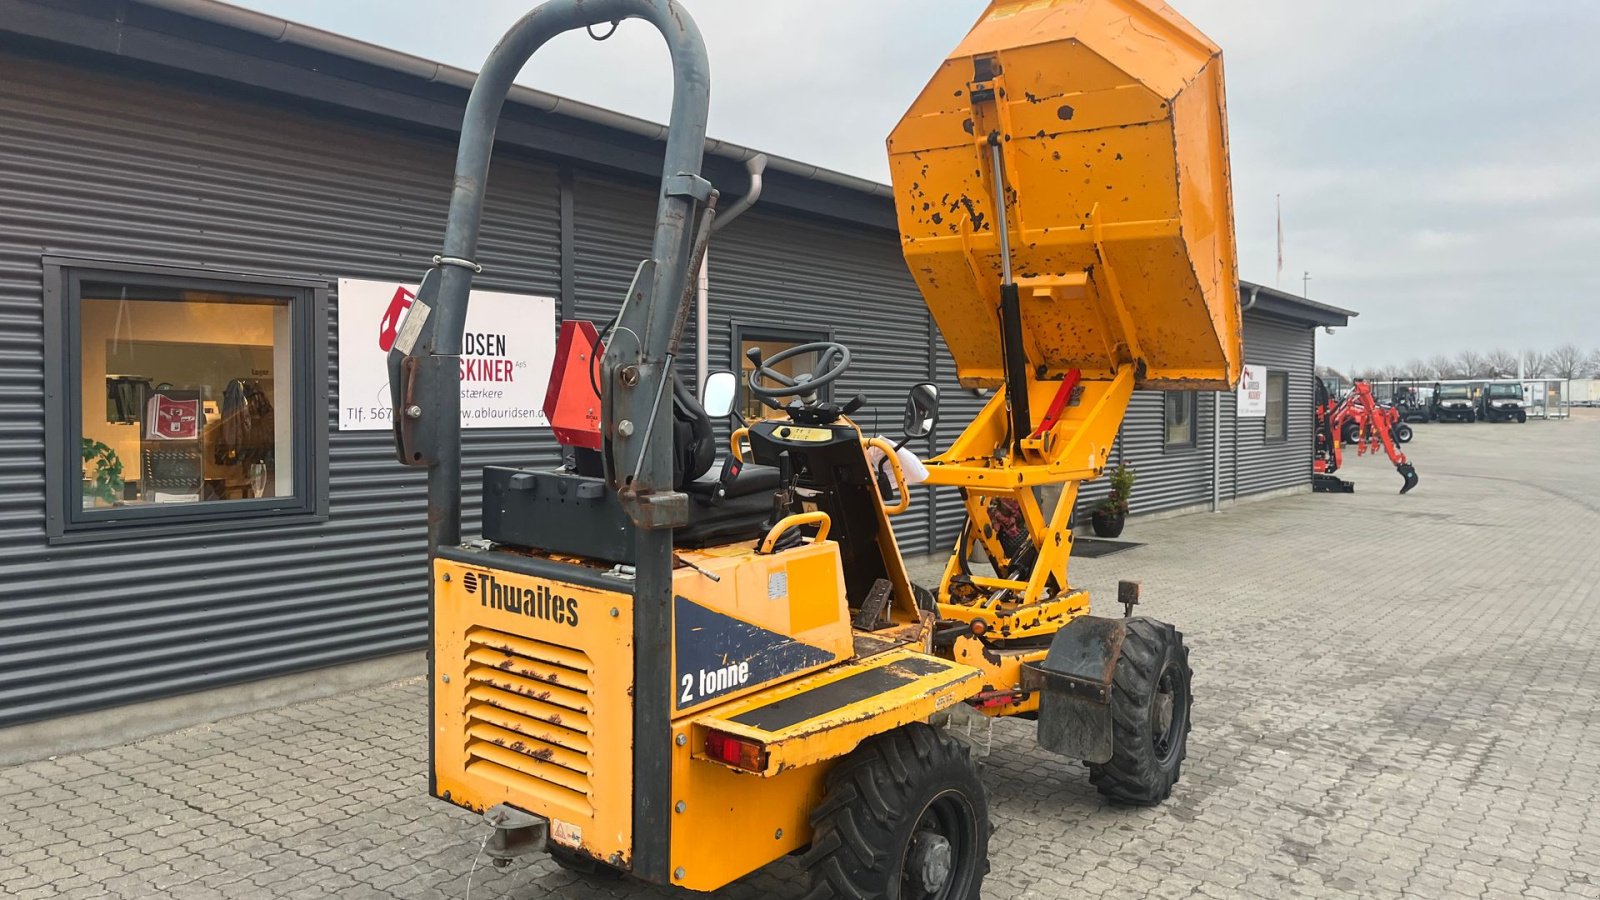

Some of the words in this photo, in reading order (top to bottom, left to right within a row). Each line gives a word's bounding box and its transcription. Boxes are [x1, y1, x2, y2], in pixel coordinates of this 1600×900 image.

[478, 573, 578, 627] Thwaites
[681, 673, 694, 703] 2
[699, 661, 749, 697] tonne
